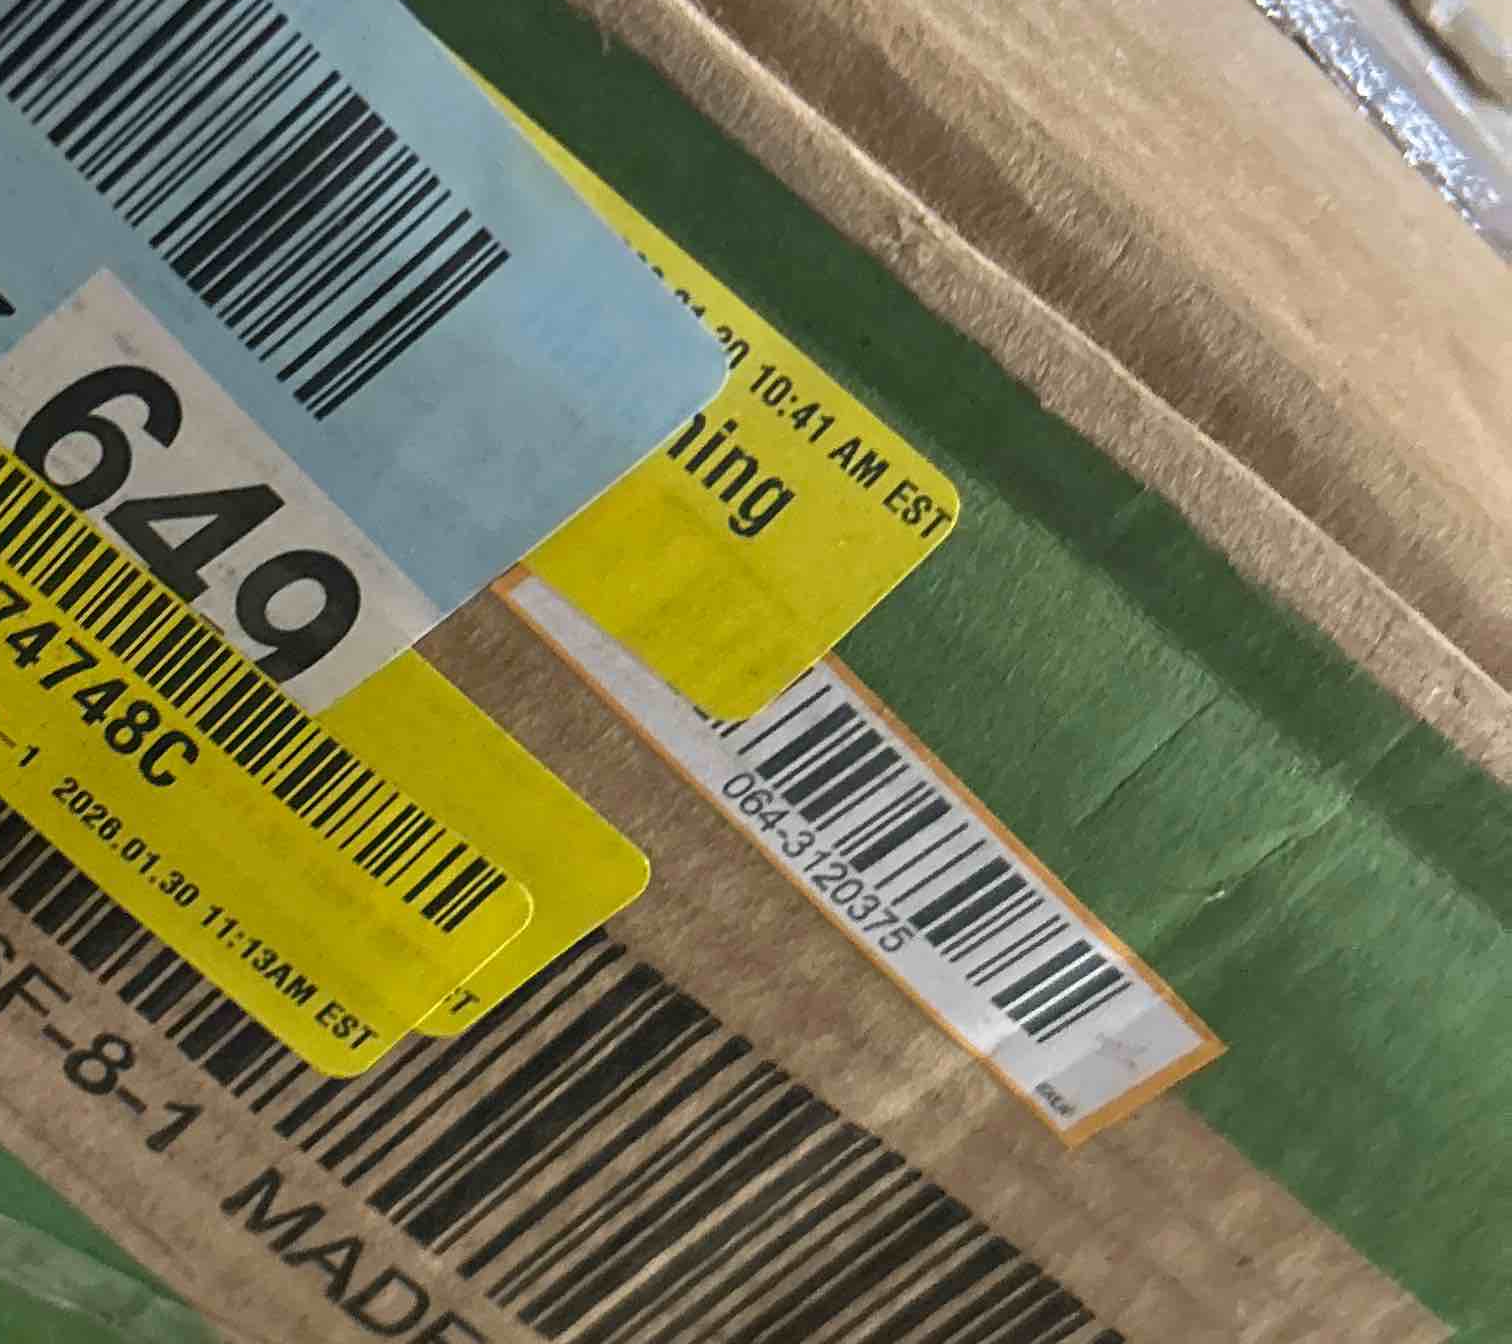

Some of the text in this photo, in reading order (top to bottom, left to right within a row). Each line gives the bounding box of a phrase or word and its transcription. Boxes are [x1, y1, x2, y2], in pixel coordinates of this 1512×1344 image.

[14, 364, 361, 684] 649
[749, 363, 954, 539] 10:41 AM EST
[51, 777, 200, 908] 2026.01.30
[201, 905, 318, 1008] 11:13AM
[314, 994, 379, 1051] EST
[720, 772, 916, 954] 064-3120375
